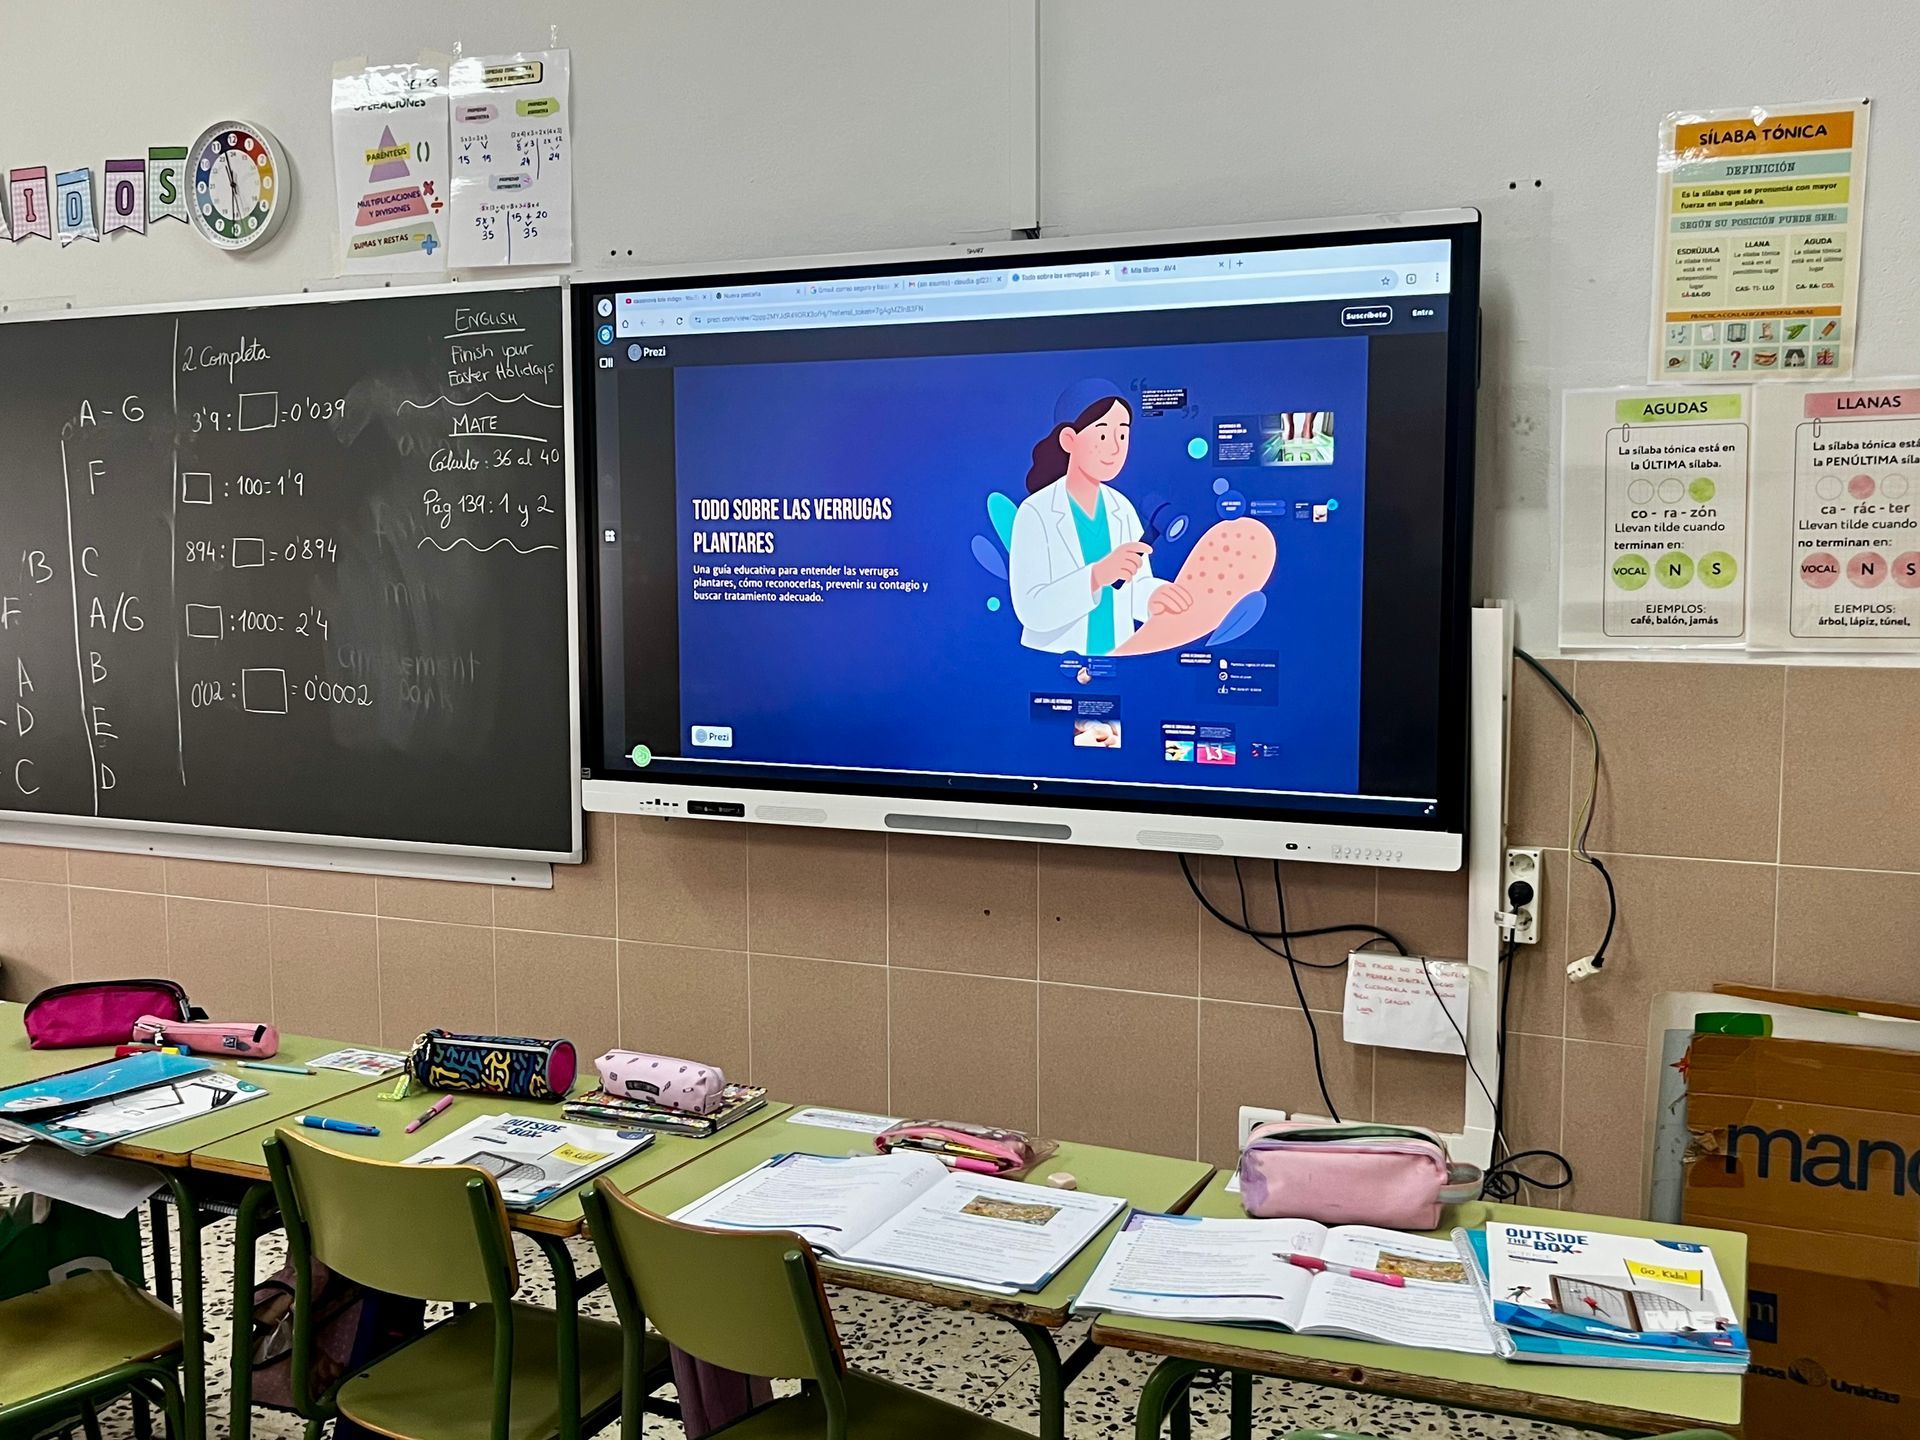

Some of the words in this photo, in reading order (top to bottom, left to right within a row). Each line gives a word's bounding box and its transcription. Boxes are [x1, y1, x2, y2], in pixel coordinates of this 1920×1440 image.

[1700, 128, 1756, 146] SÍLABA
[1762, 124, 1828, 141] TÓNICA
[458, 156, 470, 164] 15
[1726, 161, 1796, 176] DEFINICIÓN
[1755, 185, 1793, 195] pronuncia
[1812, 182, 1837, 191] mayor
[24, 188, 37, 222] I
[66, 191, 83, 226] D
[115, 180, 135, 216] O
[159, 168, 177, 204] S
[357, 190, 421, 208] MULTIPLICACIONES
[1681, 200, 1705, 209] fuerza
[1735, 197, 1764, 207] palabra.
[369, 210, 374, 218] Y
[375, 204, 411, 217] DIVISIONES
[536, 211, 548, 219] 20
[1680, 218, 1712, 229] SEGÚN
[1715, 219, 1728, 227] SU
[1732, 215, 1775, 226] POSICIÓN
[1779, 213, 1812, 223] PUEDE
[482, 230, 494, 240] 35
[524, 227, 538, 238] 35
[354, 240, 376, 250] SUMAS
[384, 234, 409, 244] RESTAS
[1677, 247, 1720, 255] ESDRÚJULA
[455, 308, 518, 332] ENGLISH
[451, 343, 494, 365] Finish
[502, 344, 534, 368] your
[643, 346, 667, 357] Prezi
[182, 347, 197, 371] 2
[200, 336, 271, 384] Completa
[448, 367, 490, 387] Easter
[496, 363, 555, 385] Holidays
[1643, 401, 1708, 416] AGUDAS
[1837, 395, 1901, 410] LLANAS
[452, 414, 498, 434] MATE
[1619, 446, 1630, 455] La
[1632, 445, 1662, 455] sílaba
[1664, 443, 1696, 454] tónica
[1699, 442, 1720, 453] está
[1722, 444, 1735, 453] en
[1813, 442, 1825, 451] La
[1828, 440, 1859, 450] sílaba
[1861, 440, 1896, 450] tónica
[493, 448, 512, 468] 36
[517, 449, 532, 467] al
[540, 449, 560, 466] 40
[1631, 461, 1640, 471] la
[1642, 458, 1686, 470] ÚLTIMA
[1689, 459, 1722, 470] sílaba.
[1814, 458, 1824, 467] la
[1826, 454, 1898, 466] PENÚLTIMA
[89, 460, 106, 495] F
[423, 489, 452, 529] Pág
[500, 493, 510, 513] 1
[518, 504, 529, 527] y
[536, 495, 555, 514] 2
[693, 499, 730, 520] TODO
[733, 499, 779, 520] SOBRE
[783, 499, 811, 520] LAS
[813, 497, 892, 520] VERRUGAS
[1690, 505, 1717, 518] zón
[1889, 503, 1910, 513] ter
[1615, 523, 1651, 533] Llevan
[1654, 522, 1680, 532] tilde
[1683, 521, 1725, 532] cuando
[1799, 519, 1837, 530] Llevan
[1840, 519, 1869, 530] tilde
[1872, 519, 1917, 530] cuando
[693, 532, 774, 553] PLANTARES
[1614, 540, 1664, 550] terminan
[1666, 540, 1684, 549] en:
[1798, 539, 1813, 547] no
[1816, 537, 1870, 547] terminan
[1873, 538, 1892, 547] en:
[81, 547, 99, 577] C
[693, 565, 711, 575] Una
[713, 564, 732, 577] guía
[734, 565, 776, 575] educativa
[778, 566, 798, 577] para
[800, 566, 841, 576] entender
[844, 566, 856, 576] las
[859, 567, 899, 579] verrugas
[1613, 567, 1647, 576] VOCAL
[1669, 563, 1681, 576] N
[1712, 563, 1721, 575] S
[1801, 565, 1837, 573] VOCAL
[1861, 563, 1874, 575] N
[1906, 563, 1916, 576] S
[693, 579, 736, 590] plantares,
[739, 579, 763, 589] cómo
[765, 579, 823, 590] reconocerlas,
[826, 579, 863, 592] prevenir
[866, 582, 877, 590] su
[879, 581, 920, 592] contagio
[922, 582, 929, 592] y
[693, 591, 722, 601] buscar
[724, 592, 776, 602] tratamiento
[779, 592, 824, 602] adecuado.
[1646, 604, 1706, 614] EJEMPLOS:
[1834, 604, 1896, 614] EJEMPLOS:
[1631, 615, 1654, 626] café,
[1656, 615, 1688, 626] balón,
[1689, 615, 1719, 626] jamás
[1818, 616, 1848, 626] árbol,
[1850, 616, 1878, 627] lápiz,
[1880, 616, 1910, 627] túnel,
[90, 651, 108, 684] B
[17, 656, 34, 697] A
[93, 705, 119, 739] E
[709, 732, 730, 742] Prezi
[15, 758, 40, 795] C
[101, 762, 116, 790] D
[504, 1119, 567, 1133] OUTSIDE
[508, 1126, 537, 1138] BOX
[1506, 1228, 1588, 1245] OUTSIDE
[1534, 1241, 1574, 1254] BOX
[1831, 1378, 1900, 1404] Unidas
